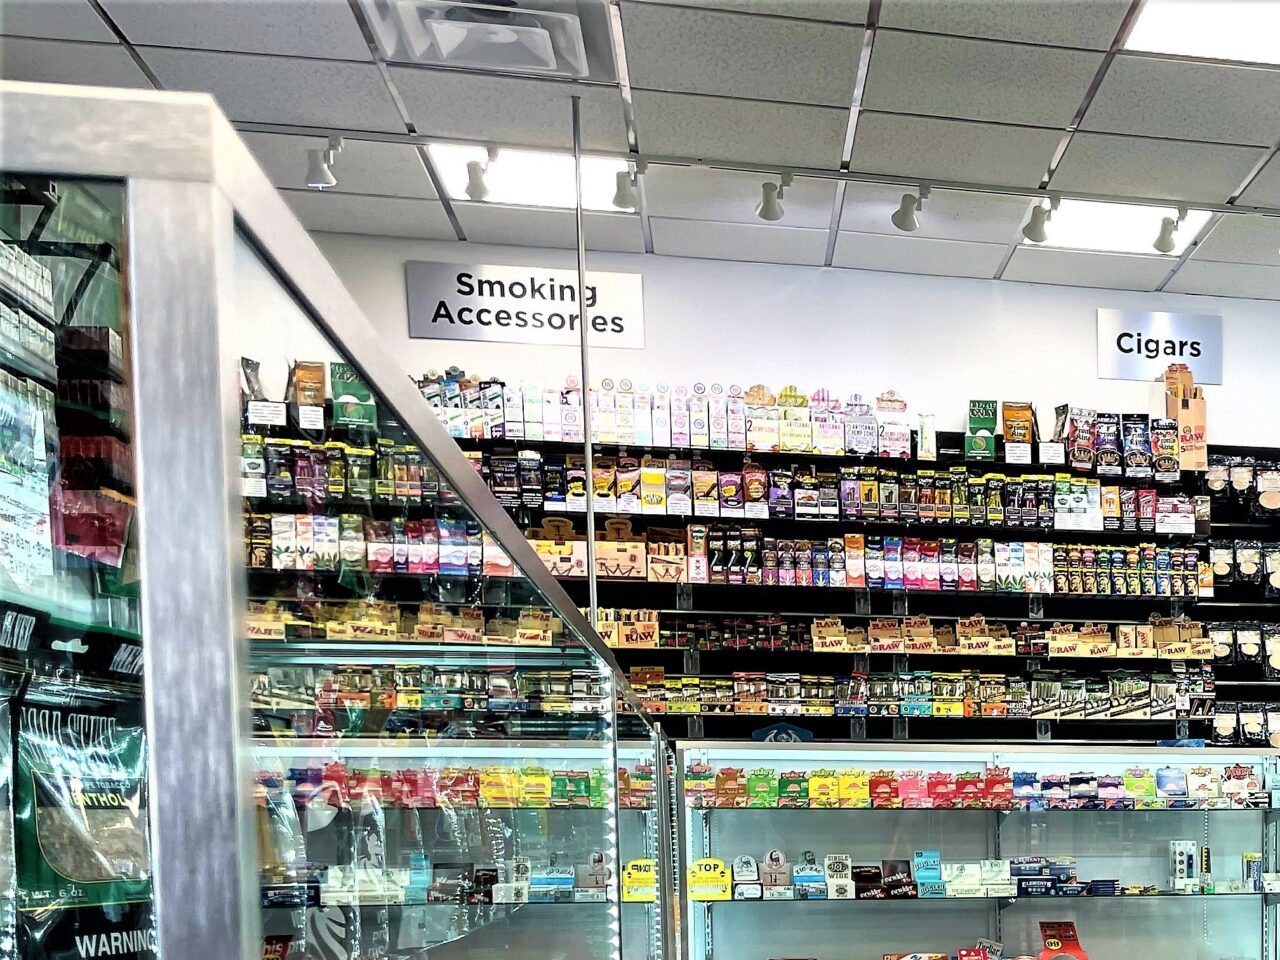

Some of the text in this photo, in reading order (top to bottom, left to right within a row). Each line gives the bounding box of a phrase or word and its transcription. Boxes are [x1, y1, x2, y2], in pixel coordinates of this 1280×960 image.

[456, 272, 597, 307] Smoking
[431, 301, 624, 333] Accessores
[1116, 332, 1202, 359] Cigars
[969, 401, 996, 410] LEAF
[969, 409, 996, 418] ONLY
[1180, 433, 1204, 443] RAW
[872, 620, 898, 629] RAW
[959, 619, 983, 628] RAW
[1052, 626, 1072, 635] RAW
[625, 631, 655, 642] RAW
[820, 638, 844, 648] RAW
[879, 641, 900, 651] RAW
[911, 641, 933, 650] RAW
[967, 641, 990, 650] RAW
[1056, 645, 1078, 654] RAW
[1090, 646, 1109, 655] RAW
[70, 791, 126, 807] ENTHOL
[696, 863, 720, 872] TOP
